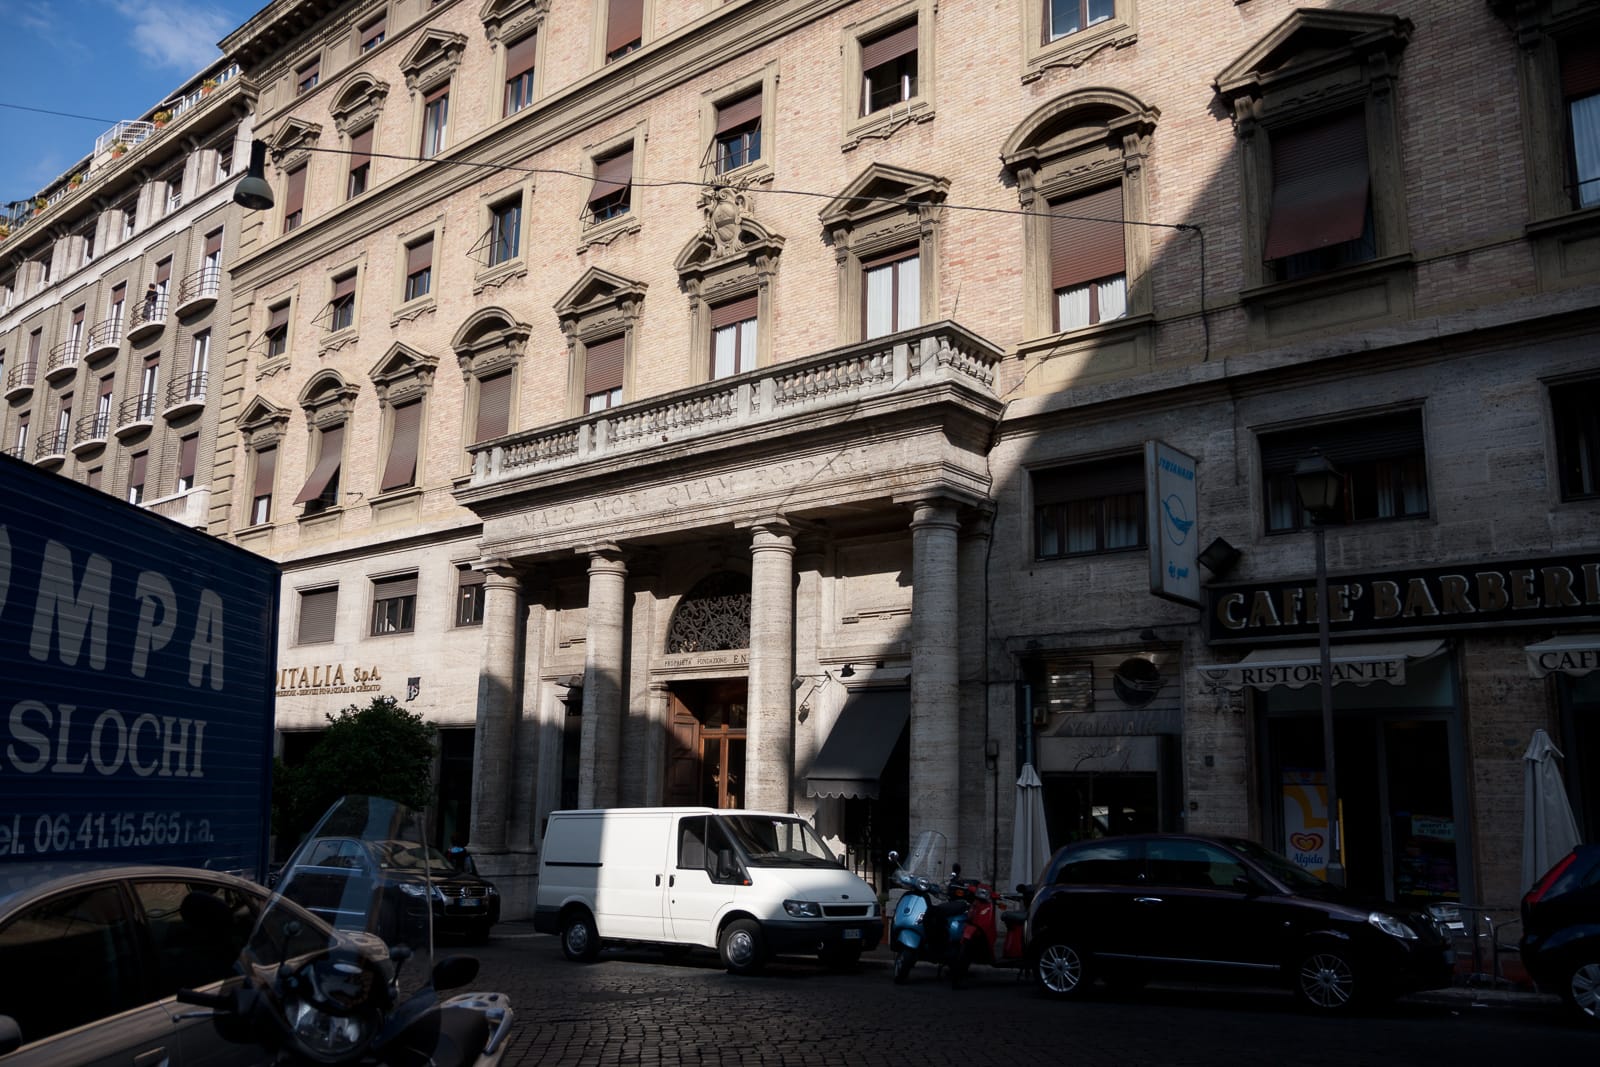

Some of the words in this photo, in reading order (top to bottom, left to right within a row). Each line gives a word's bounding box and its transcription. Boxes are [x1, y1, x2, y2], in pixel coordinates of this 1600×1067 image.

[1539, 650, 1600, 671] CAF
[276, 664, 346, 689] ITALIA
[0, 699, 208, 778] SLOCHI
[34, 811, 181, 853] 06.41.15.565
[1294, 852, 1323, 867] Algida
